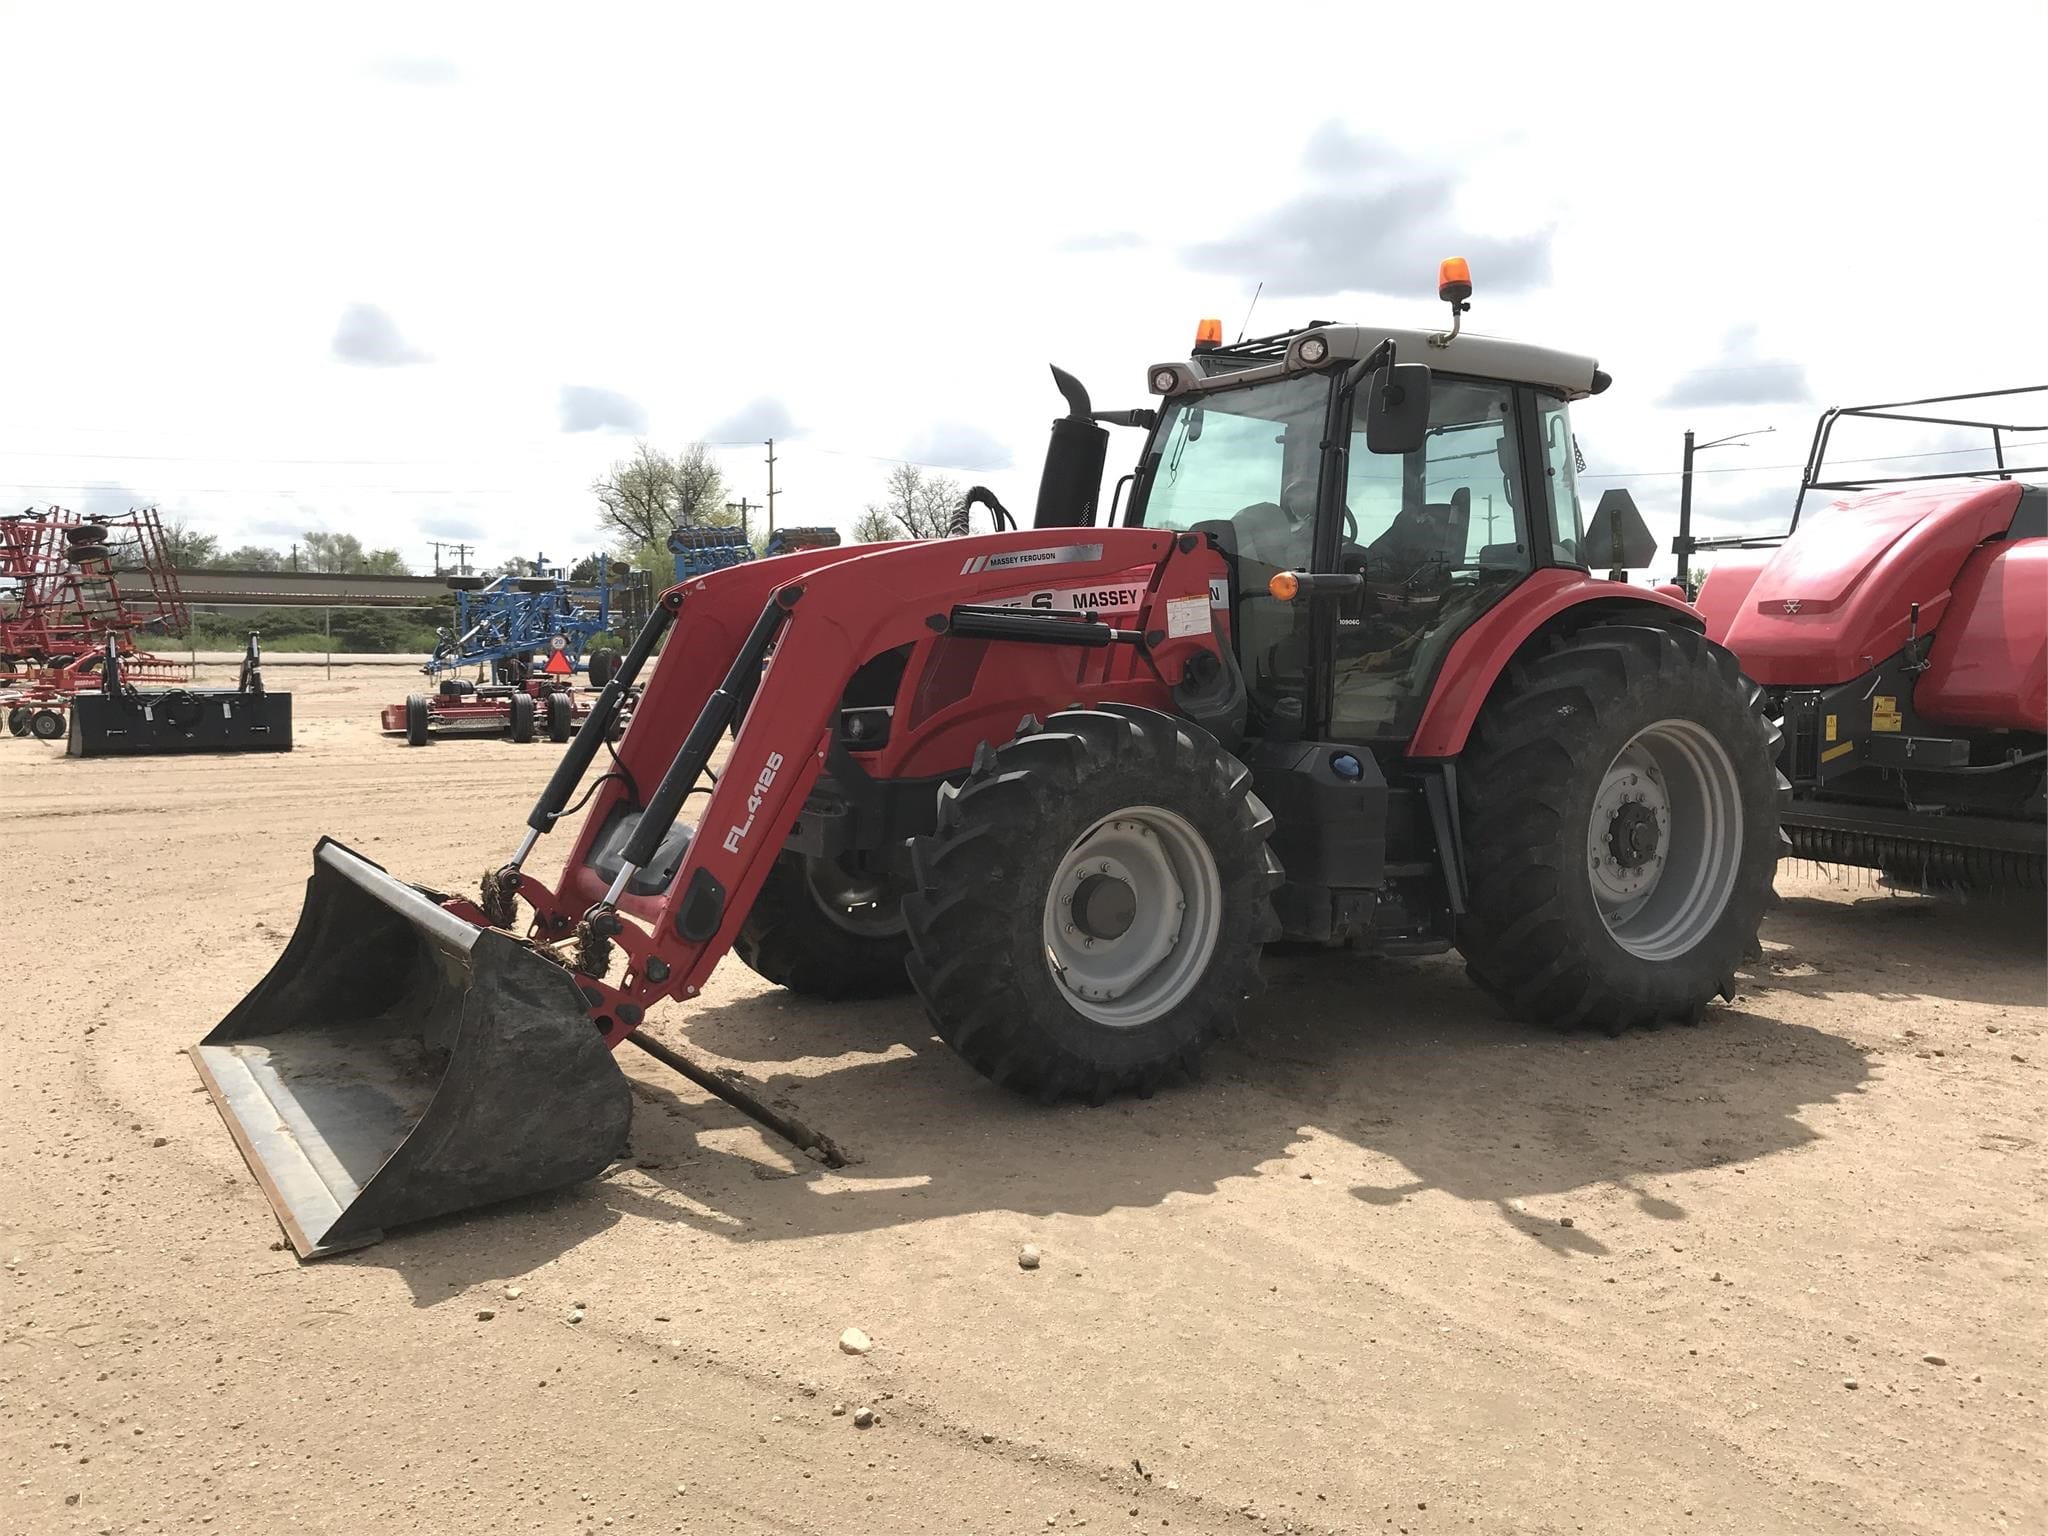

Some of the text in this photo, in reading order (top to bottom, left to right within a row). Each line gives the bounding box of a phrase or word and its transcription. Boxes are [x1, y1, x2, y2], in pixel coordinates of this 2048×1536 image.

[990, 552, 1056, 566] MASSEY FERGUSON
[1073, 589, 1137, 609] MASSEY
[723, 751, 784, 854] FL.4125
